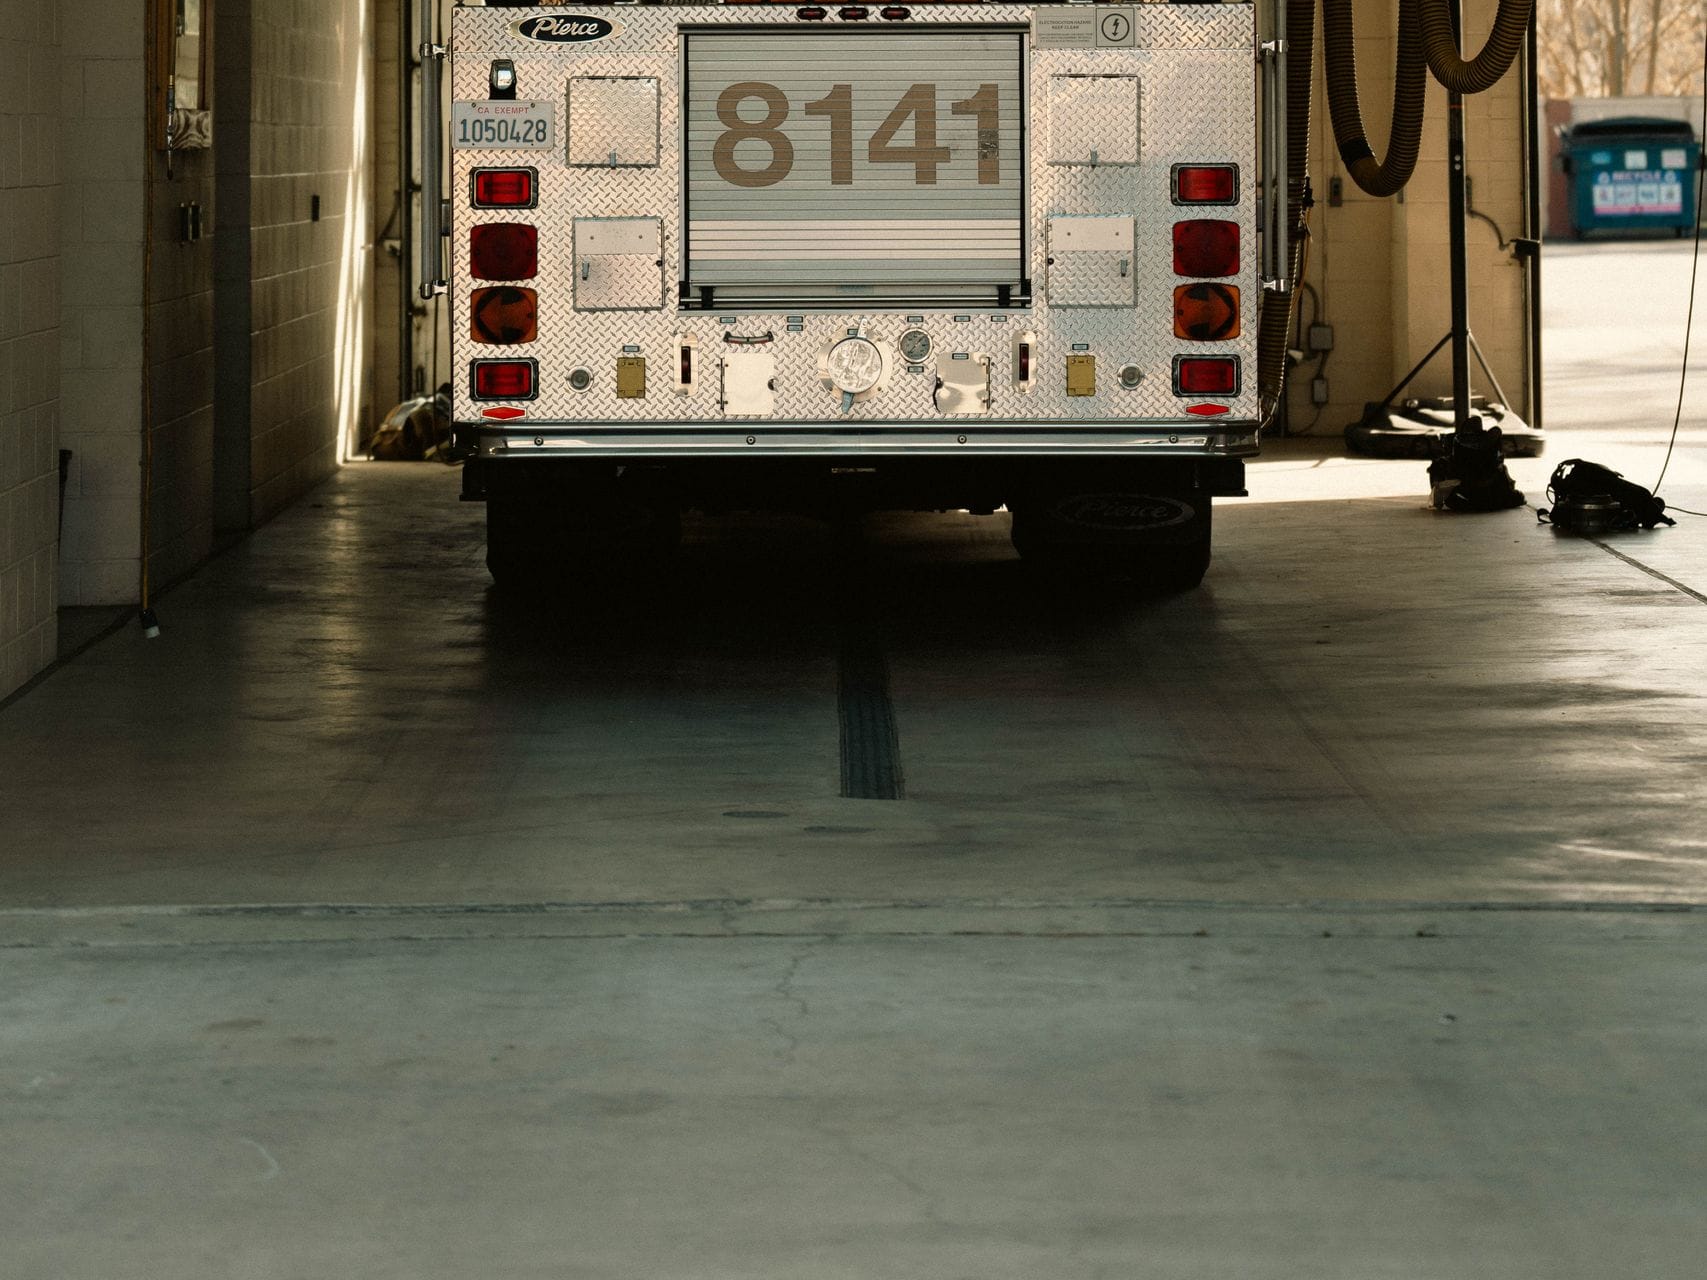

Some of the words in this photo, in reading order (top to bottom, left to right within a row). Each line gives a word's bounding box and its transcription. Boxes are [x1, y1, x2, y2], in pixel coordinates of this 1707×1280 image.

[531, 16, 599, 39] Pierce
[477, 106, 490, 114] CA
[494, 106, 529, 114] EXEMPT
[458, 118, 547, 142] 1050428
[713, 81, 1000, 187] 8141
